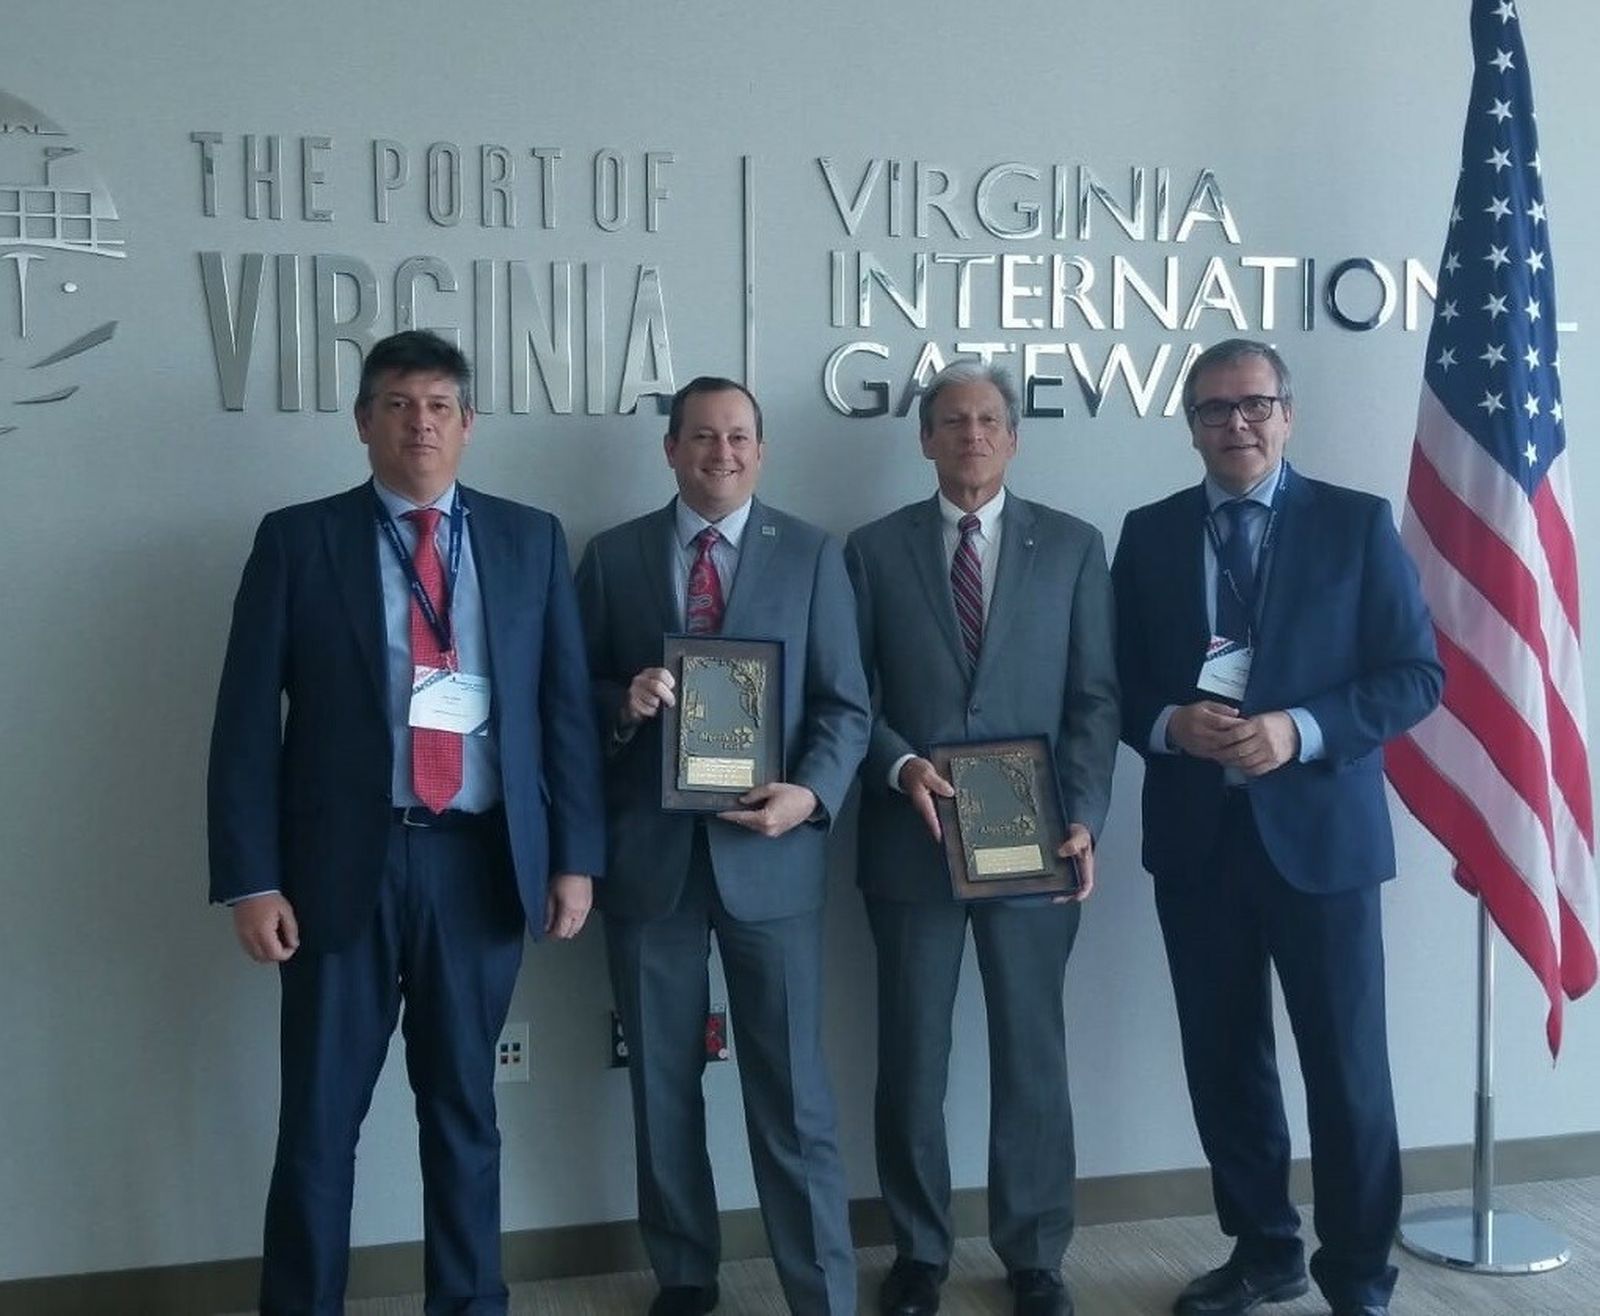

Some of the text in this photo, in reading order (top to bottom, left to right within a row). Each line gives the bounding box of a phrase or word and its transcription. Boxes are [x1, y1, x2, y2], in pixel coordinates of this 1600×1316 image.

[190, 131, 677, 233] THE PORT OF
[817, 156, 1241, 244] VIRGINIA
[198, 252, 677, 415] VIRGINIA
[830, 250, 1578, 332] INTERNATION
[824, 341, 1277, 419] GATEW
